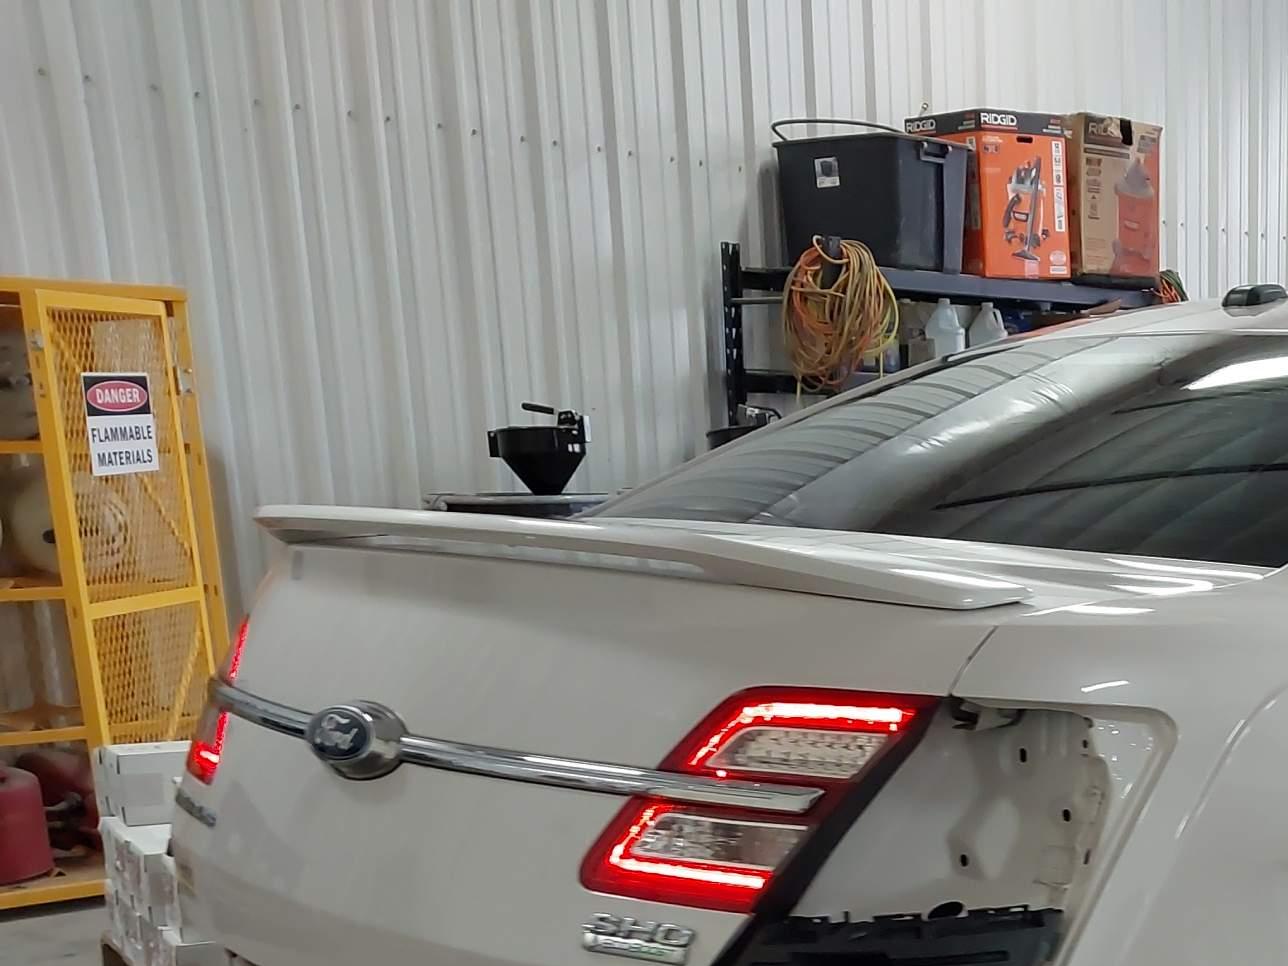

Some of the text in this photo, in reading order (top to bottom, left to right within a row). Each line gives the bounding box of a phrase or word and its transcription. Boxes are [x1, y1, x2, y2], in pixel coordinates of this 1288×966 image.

[905, 119, 936, 133] RIDGID
[980, 112, 1018, 126] RIDGID
[95, 388, 141, 404] DANGER
[91, 425, 153, 443] FLAMMABLE
[97, 449, 153, 467] MATERIALS
[581, 913, 694, 947] SHO
